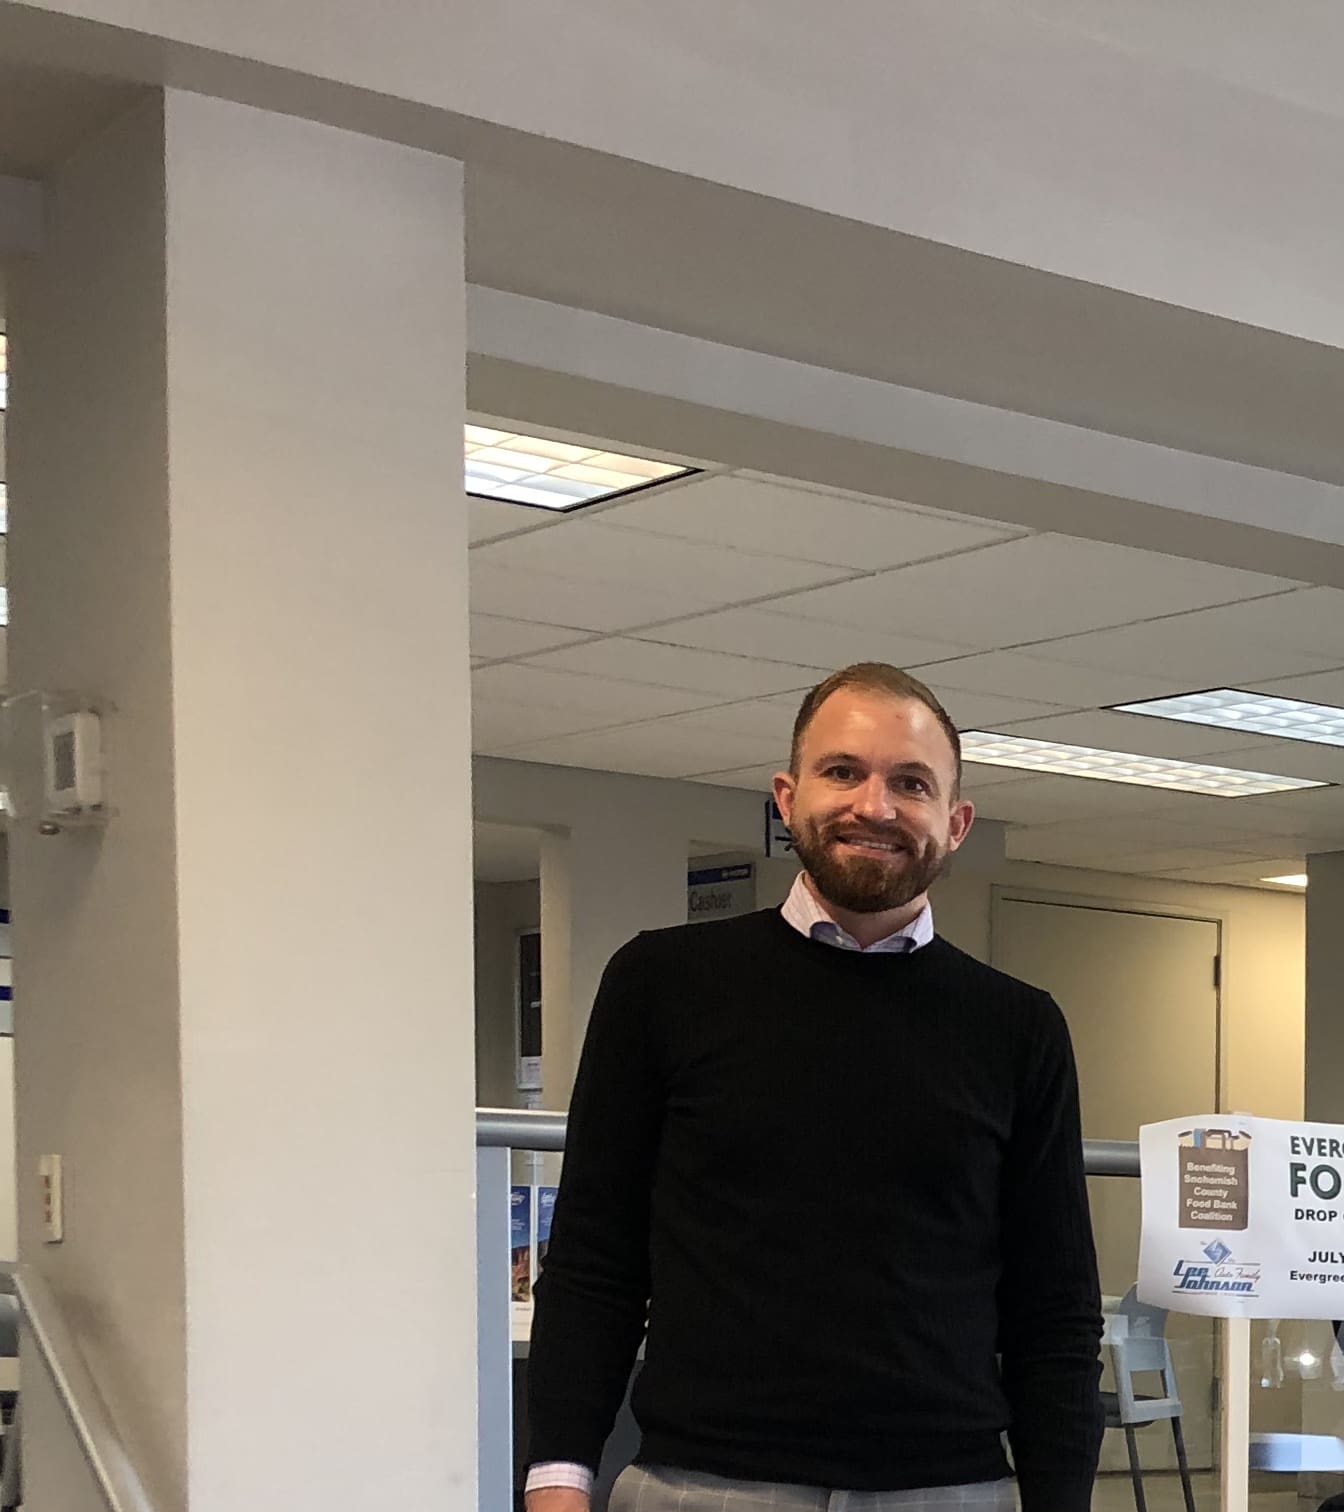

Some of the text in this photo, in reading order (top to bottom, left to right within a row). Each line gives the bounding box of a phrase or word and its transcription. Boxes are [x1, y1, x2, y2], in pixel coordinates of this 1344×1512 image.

[1186, 1161, 1236, 1176] Benefiting
[1184, 1174, 1239, 1186] Snohomish
[1193, 1186, 1229, 1199] County
[1186, 1198, 1238, 1210] Food Bank
[1190, 1210, 1233, 1222] Coalition
[1294, 1208, 1338, 1222] DROP
[1173, 1260, 1210, 1277] Lee
[1174, 1275, 1255, 1292] Johnson
